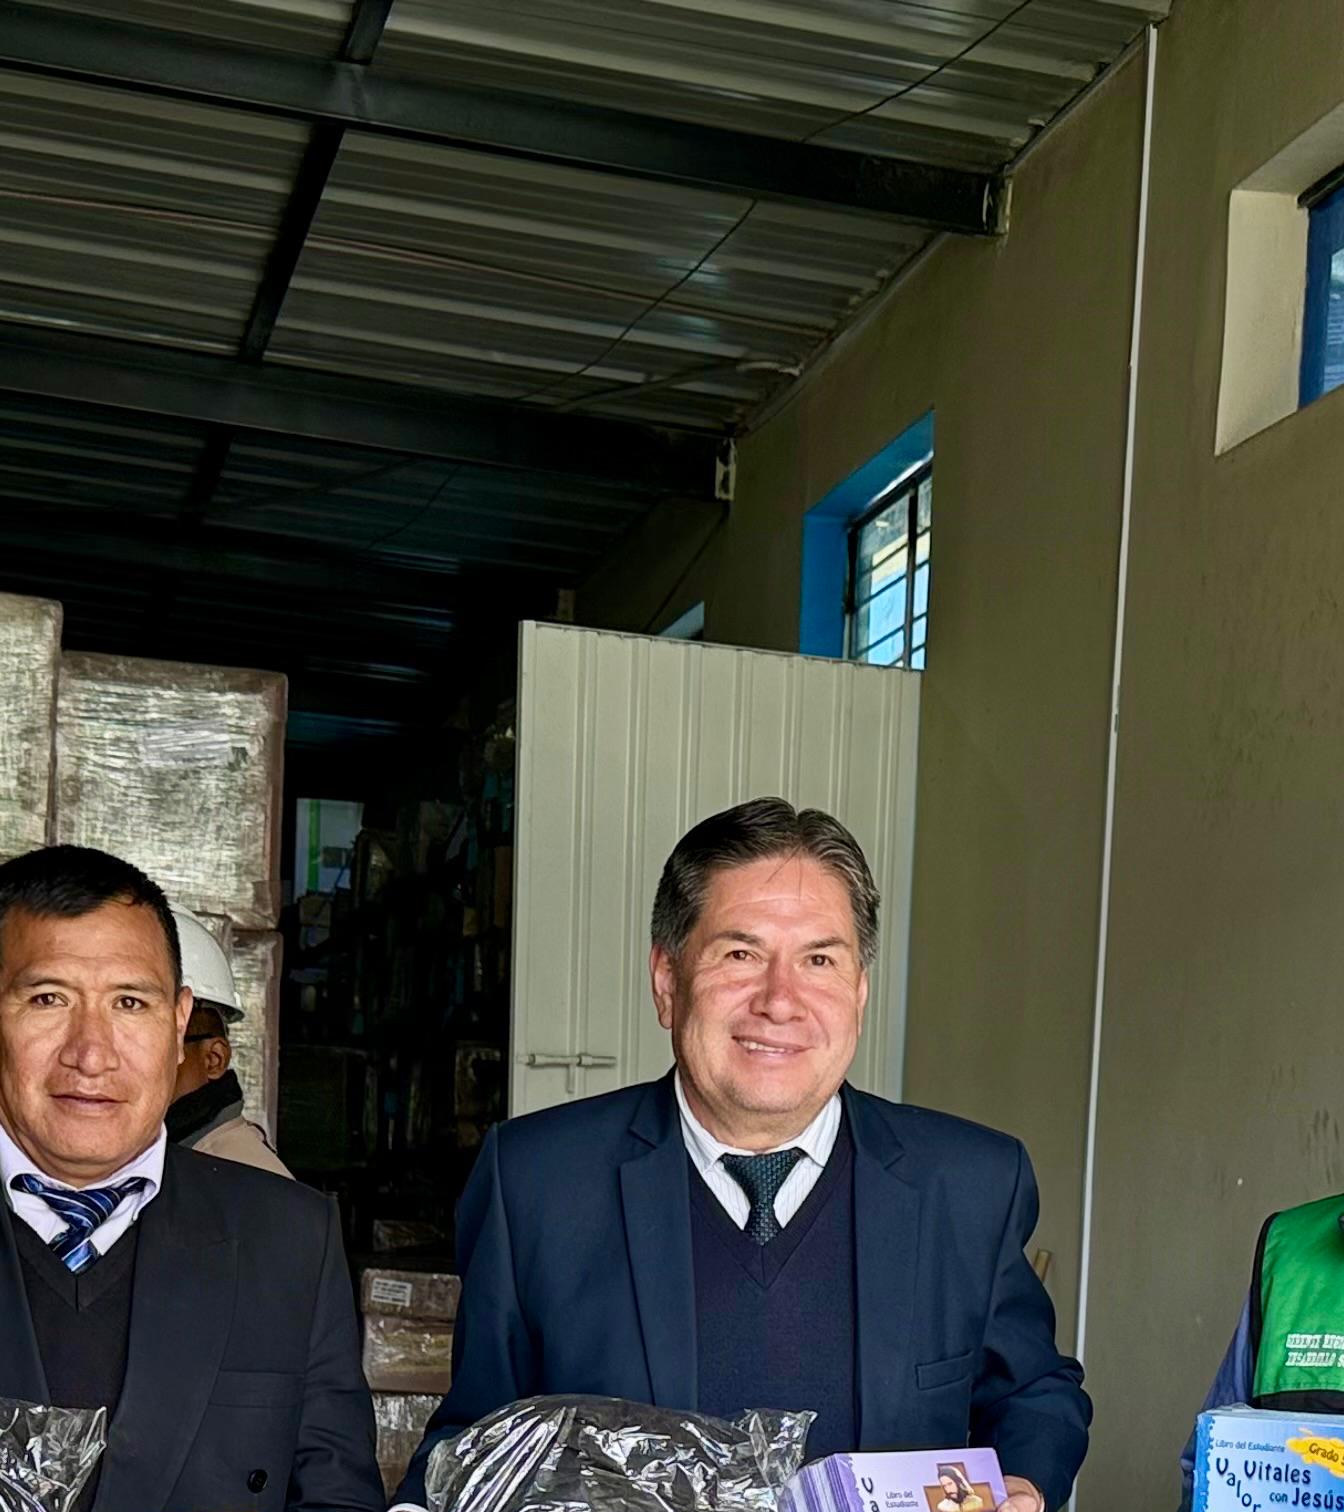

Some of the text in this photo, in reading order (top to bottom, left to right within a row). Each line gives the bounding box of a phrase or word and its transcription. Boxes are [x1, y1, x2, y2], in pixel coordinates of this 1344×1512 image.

[1235, 1440, 1246, 1450] del
[1309, 1442, 1339, 1463] Grado
[1244, 1460, 1312, 1485] Vitales
[1269, 1488, 1344, 1511] con Jesús
